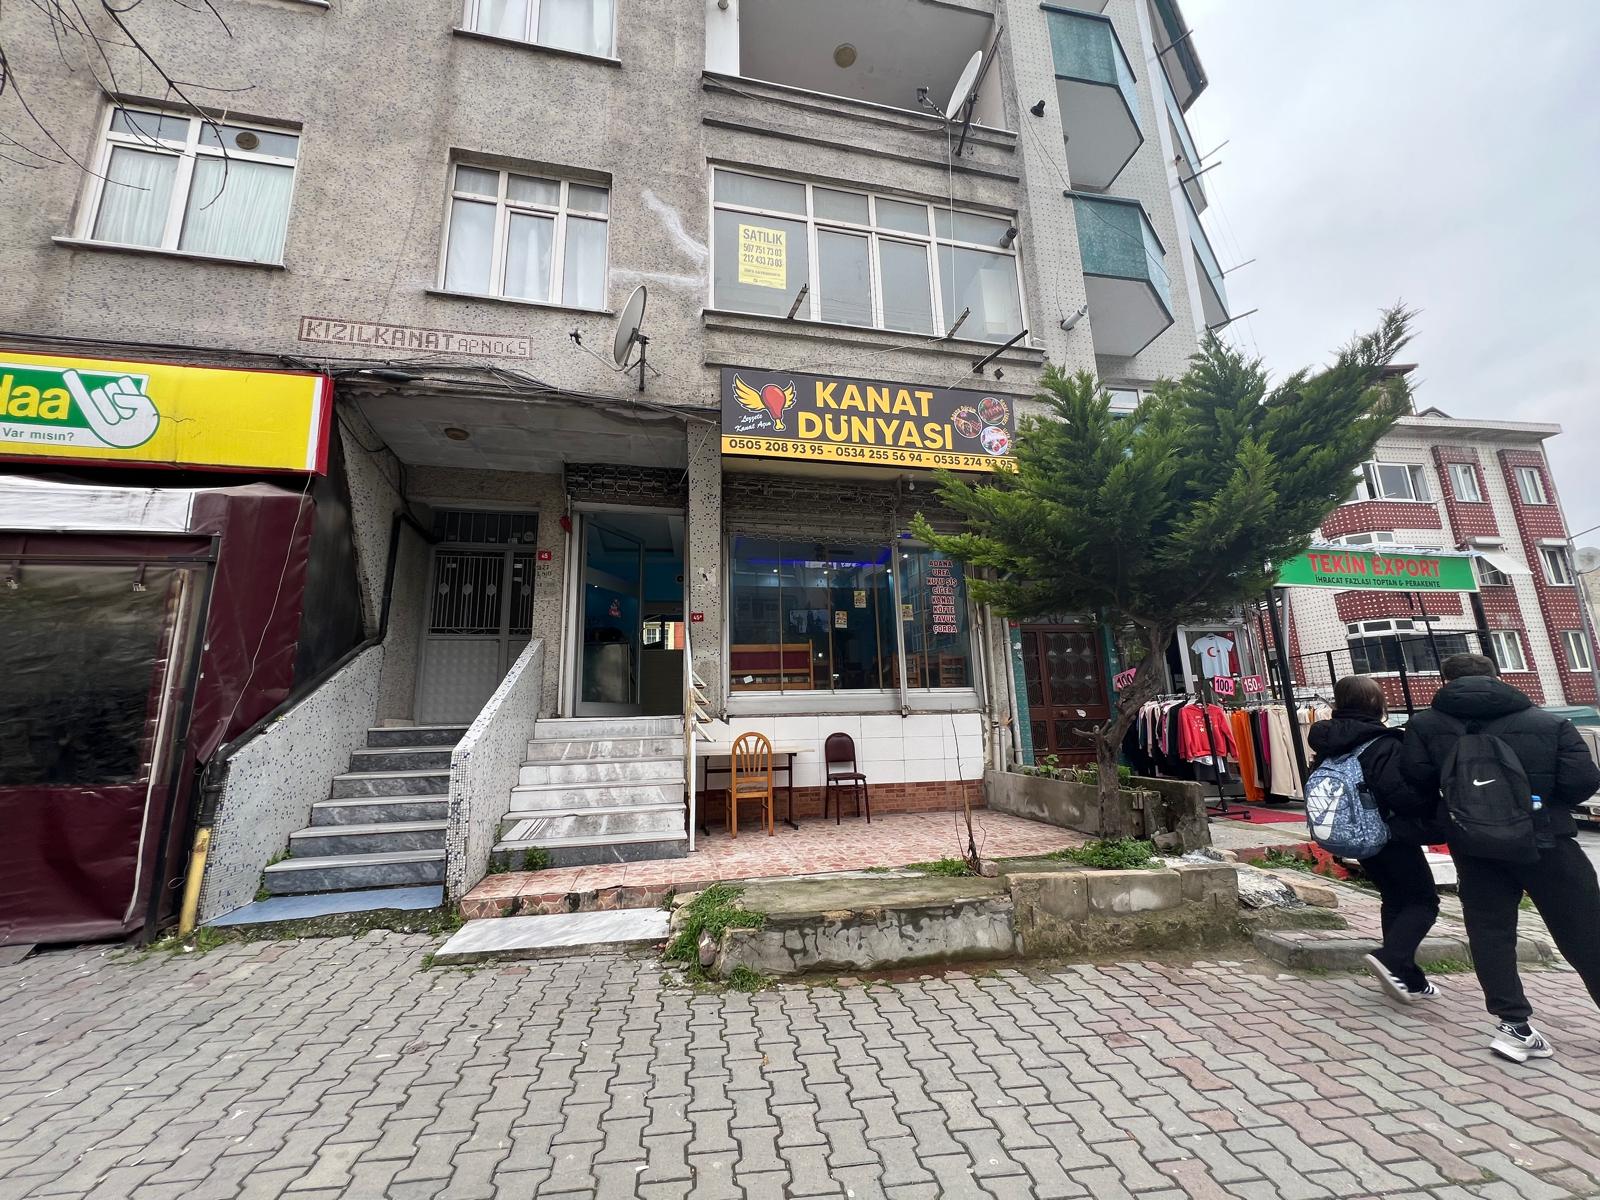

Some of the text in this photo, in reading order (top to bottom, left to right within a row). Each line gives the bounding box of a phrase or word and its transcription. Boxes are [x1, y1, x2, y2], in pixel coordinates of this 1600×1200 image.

[744, 229, 783, 245] SATILIK
[744, 254, 754, 263] 212
[306, 320, 454, 350] KIZILKANAT
[815, 381, 934, 417] KANAT
[3, 427, 74, 441] Var mısın?
[798, 411, 953, 450] DÜNYASI
[729, 438, 761, 450] 0505
[765, 441, 788, 452] 208
[791, 443, 806, 454] 93
[809, 445, 823, 455] 95
[835, 446, 865, 459] 0534
[868, 449, 889, 460] 255
[892, 452, 906, 461] 56
[909, 453, 922, 462] 94
[933, 454, 961, 465] 0535
[963, 456, 982, 467] 274
[1000, 460, 1012, 469] 95
[1307, 551, 1440, 577] TEKİN EXPORT
[1345, 577, 1372, 585] FAZLASI
[1373, 578, 1398, 586] TOPTAN
[932, 596, 955, 604] KANAT
[933, 605, 955, 613] KÖFTE
[933, 615, 956, 623] TAVUK
[933, 625, 957, 635] ÇORBA
